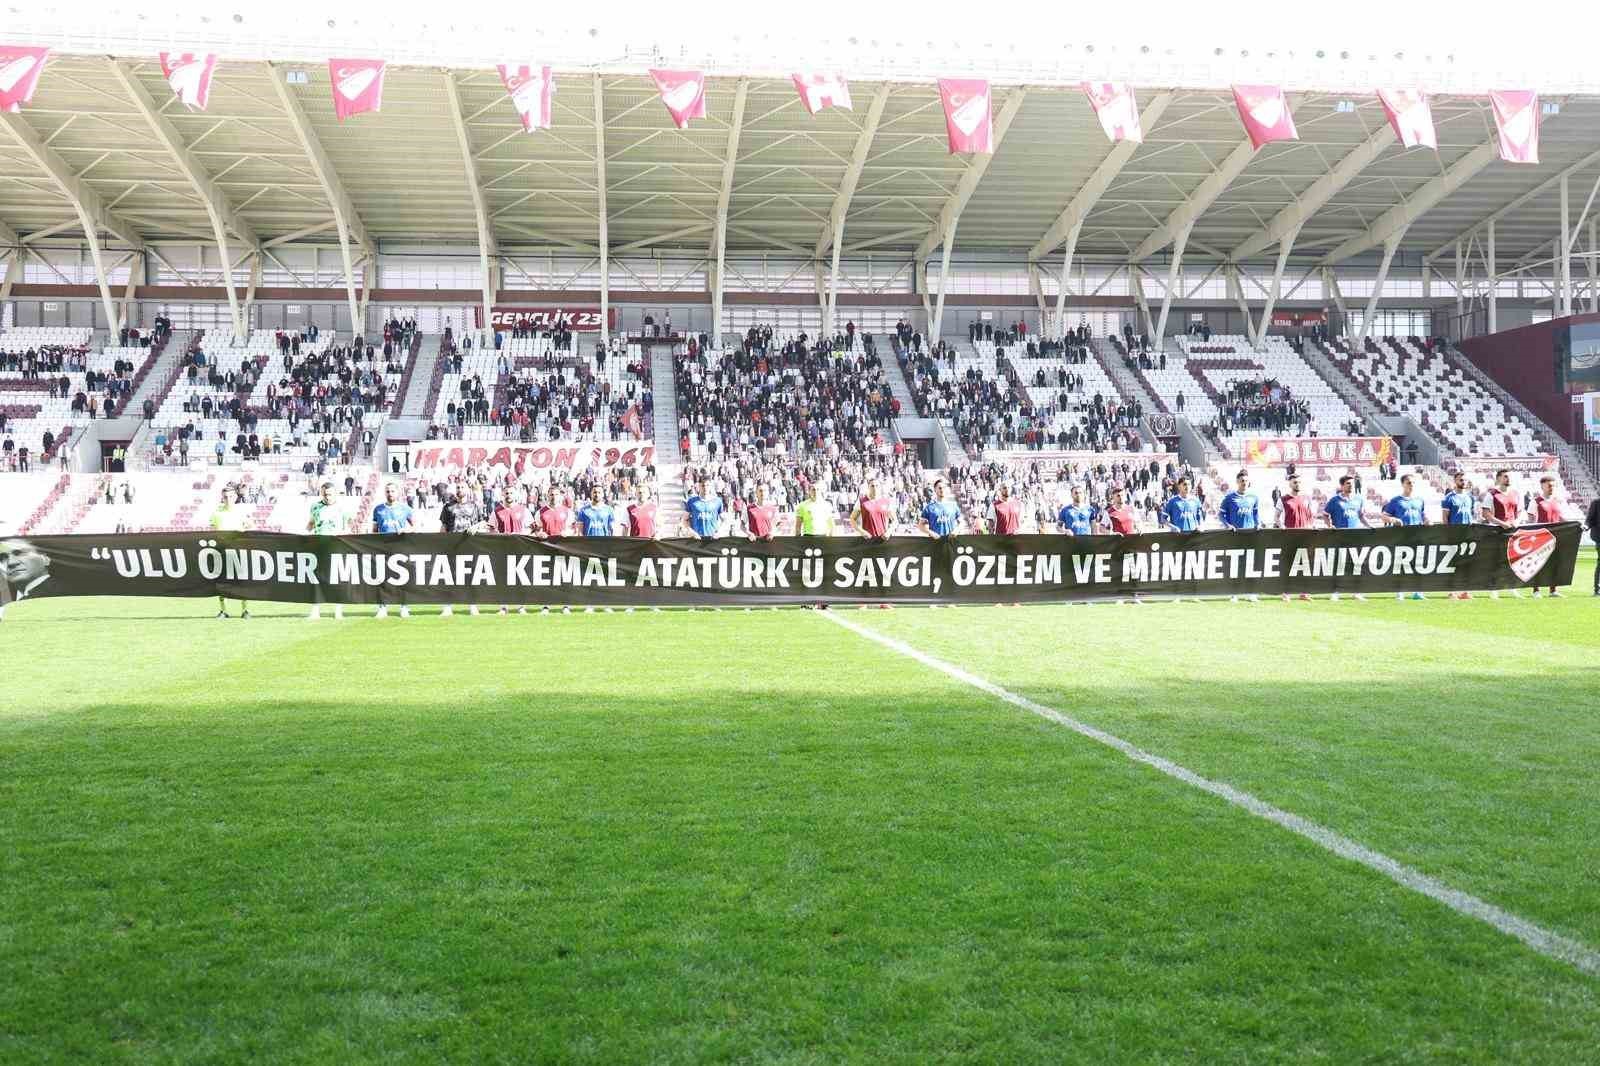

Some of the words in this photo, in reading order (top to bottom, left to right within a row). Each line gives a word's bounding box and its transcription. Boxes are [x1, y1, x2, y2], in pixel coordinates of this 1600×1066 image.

[577, 312, 602, 326] 23
[414, 447, 578, 477] MARATON
[1263, 441, 1377, 461] ABLUKA
[198, 540, 319, 585] ÖNDER
[329, 553, 497, 586] MUSTAFA
[506, 554, 626, 587] KEMAL
[634, 547, 824, 589] ATATÜRK'Ü
[834, 555, 942, 594] SAYGI,
[953, 546, 1062, 586] ÖZLEM
[1072, 553, 1112, 584] VE
[1121, 542, 1282, 583] MİNNETLE
